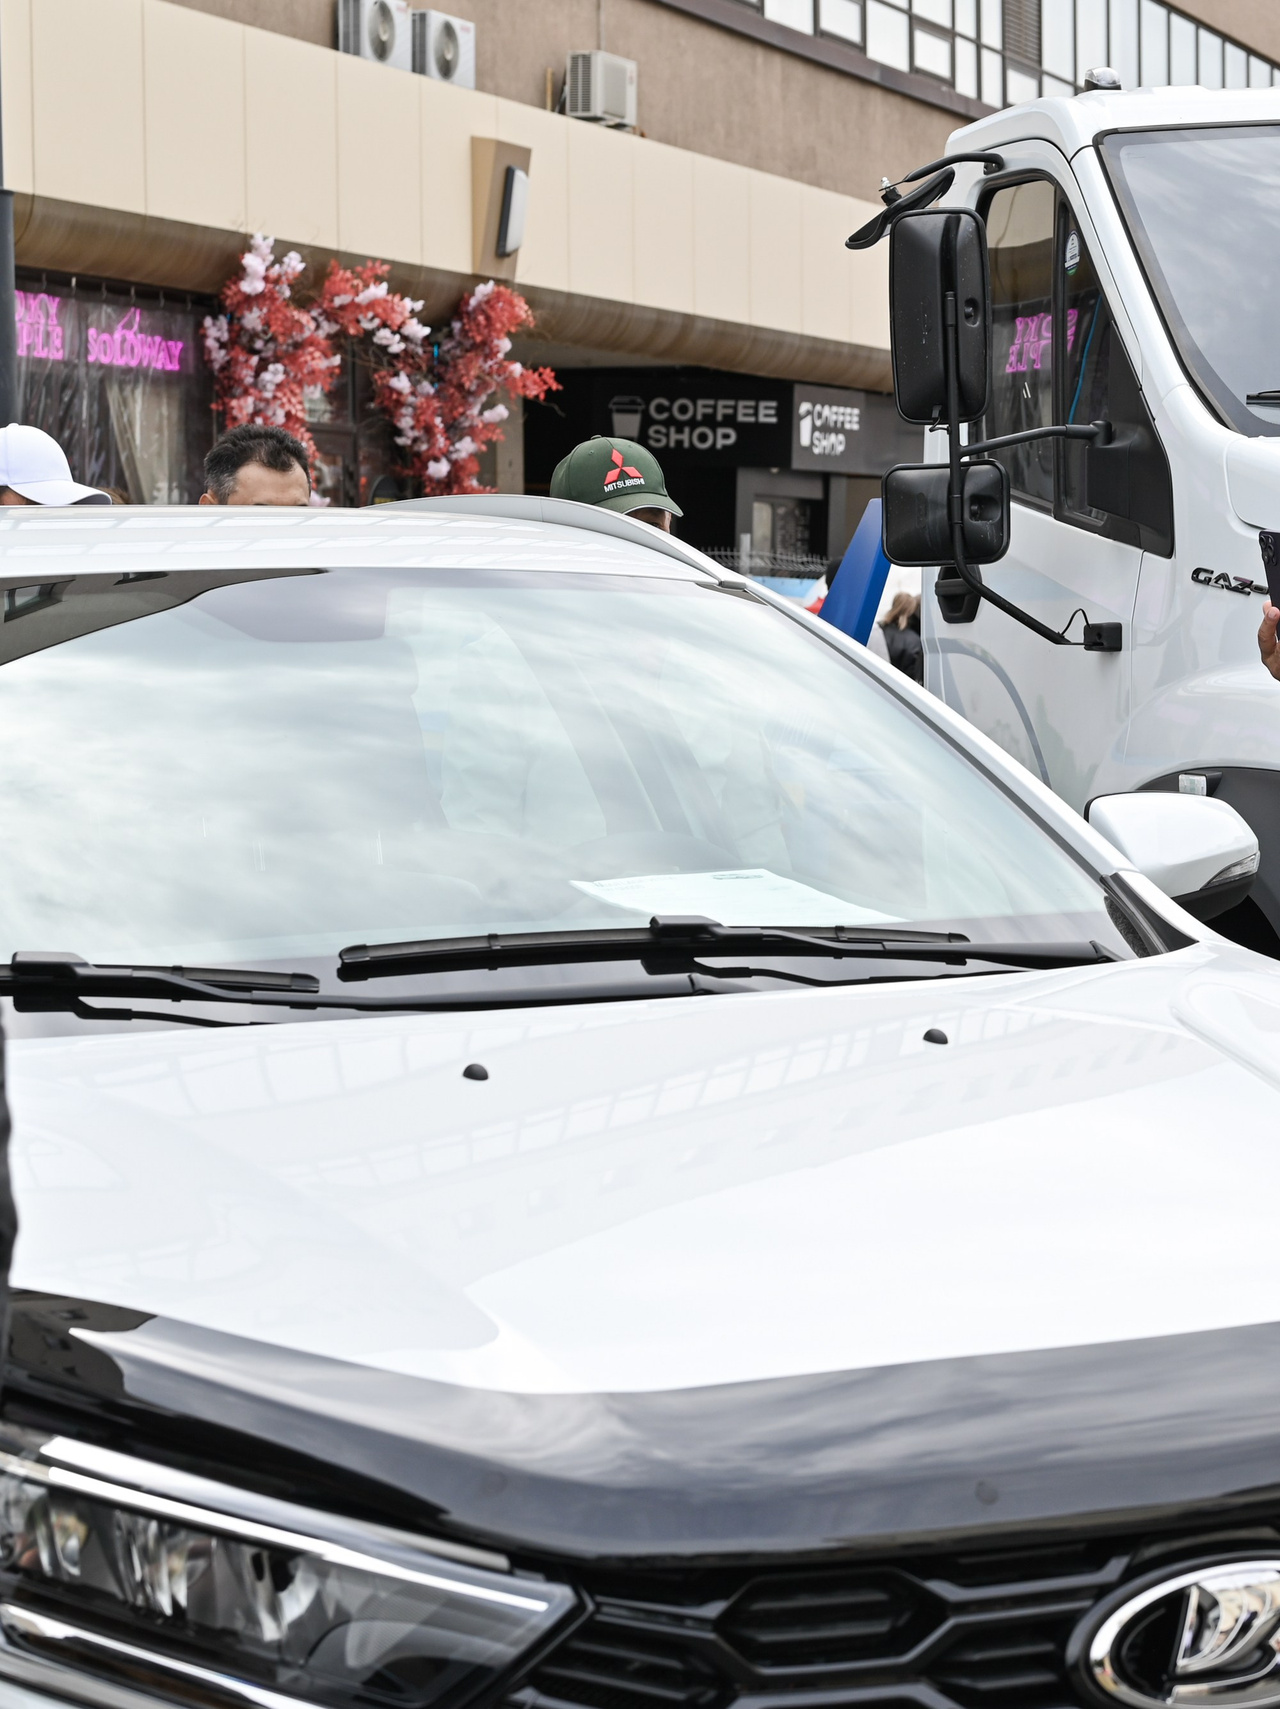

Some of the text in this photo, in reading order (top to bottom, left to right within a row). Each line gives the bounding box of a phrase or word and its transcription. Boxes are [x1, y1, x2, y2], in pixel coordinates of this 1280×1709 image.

[648, 397, 778, 423] COFFEE
[813, 403, 860, 431] COFFEE
[648, 424, 737, 450] SHOP
[812, 430, 845, 456] SHOP
[603, 478, 646, 493] MITSUBISHI
